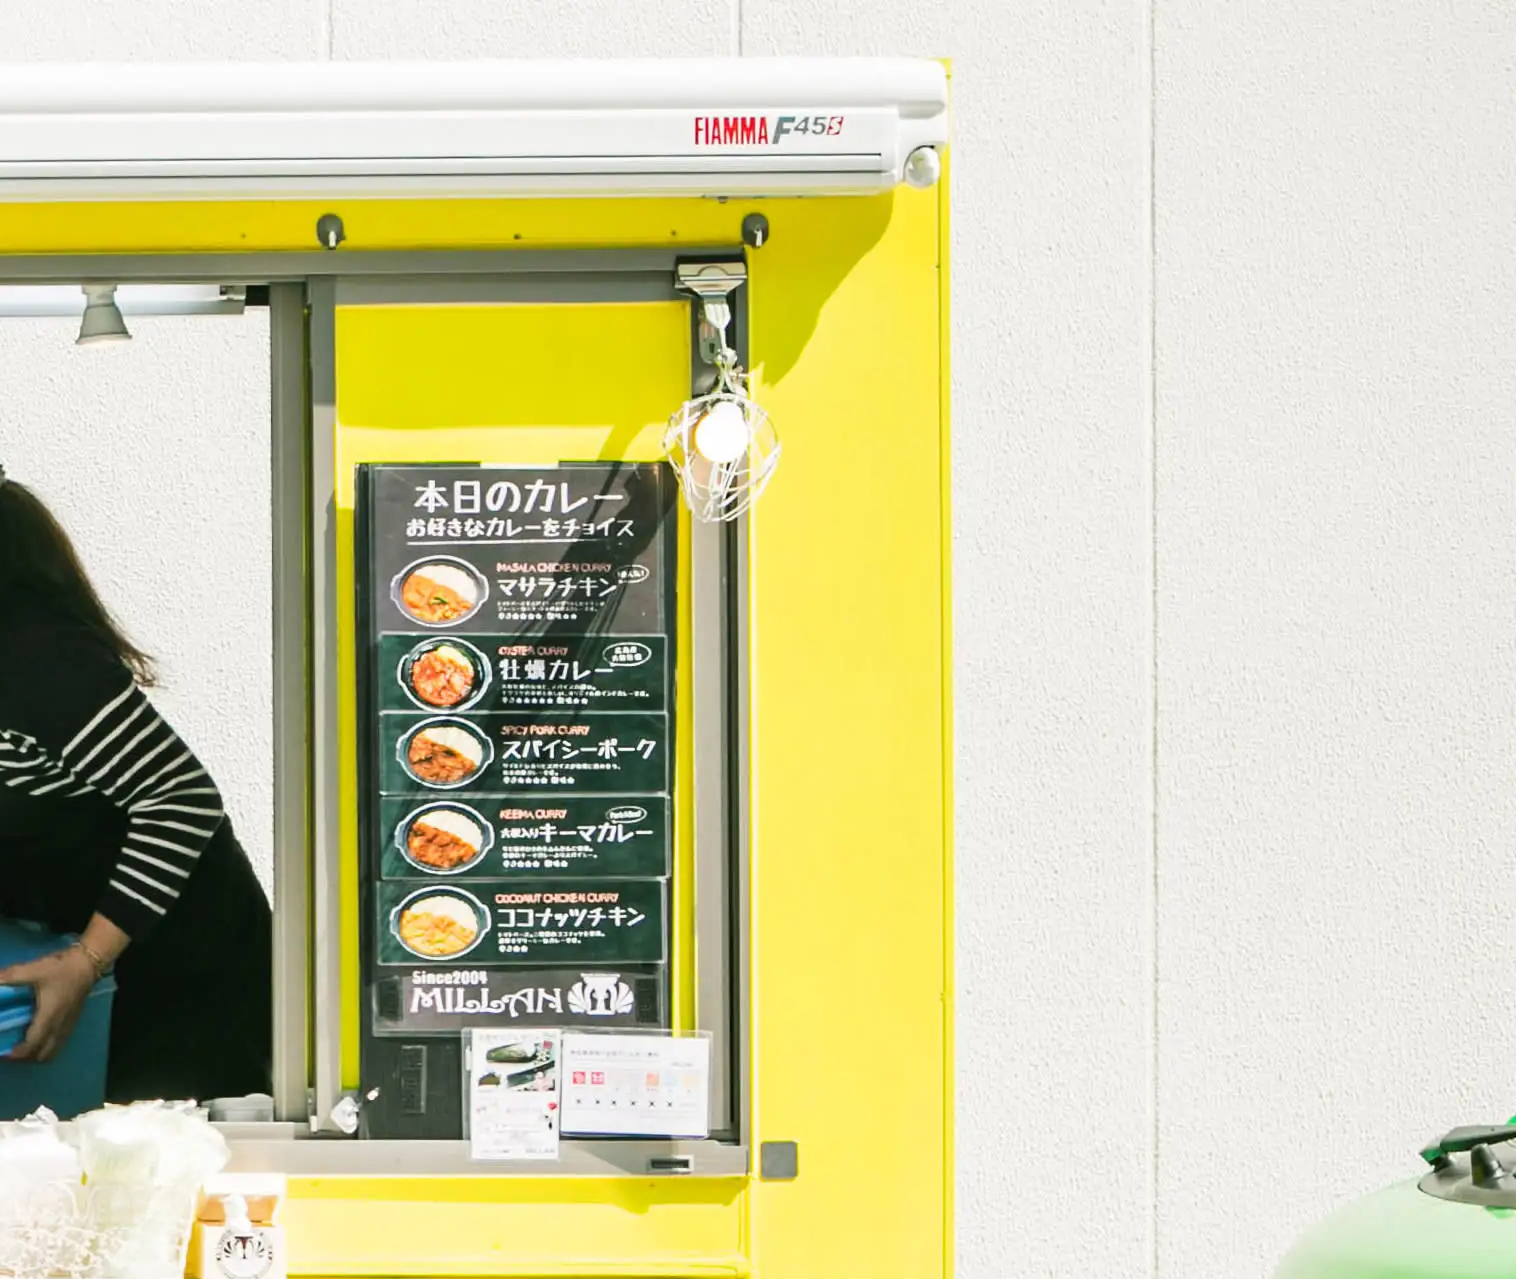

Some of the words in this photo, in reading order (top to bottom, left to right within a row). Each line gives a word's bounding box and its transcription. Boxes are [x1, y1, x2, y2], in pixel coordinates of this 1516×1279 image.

[694, 117, 769, 145] FIAMMA
[414, 478, 623, 514] 本日のカレー
[406, 517, 635, 538] お好きなカレーをチョイス
[496, 576, 617, 598] マサラチキン
[498, 658, 614, 681] 牡蠣カレー
[502, 738, 657, 760] スパイシーポーク
[496, 906, 646, 928] ココナッツチキン
[410, 987, 563, 1018] MILLAN
